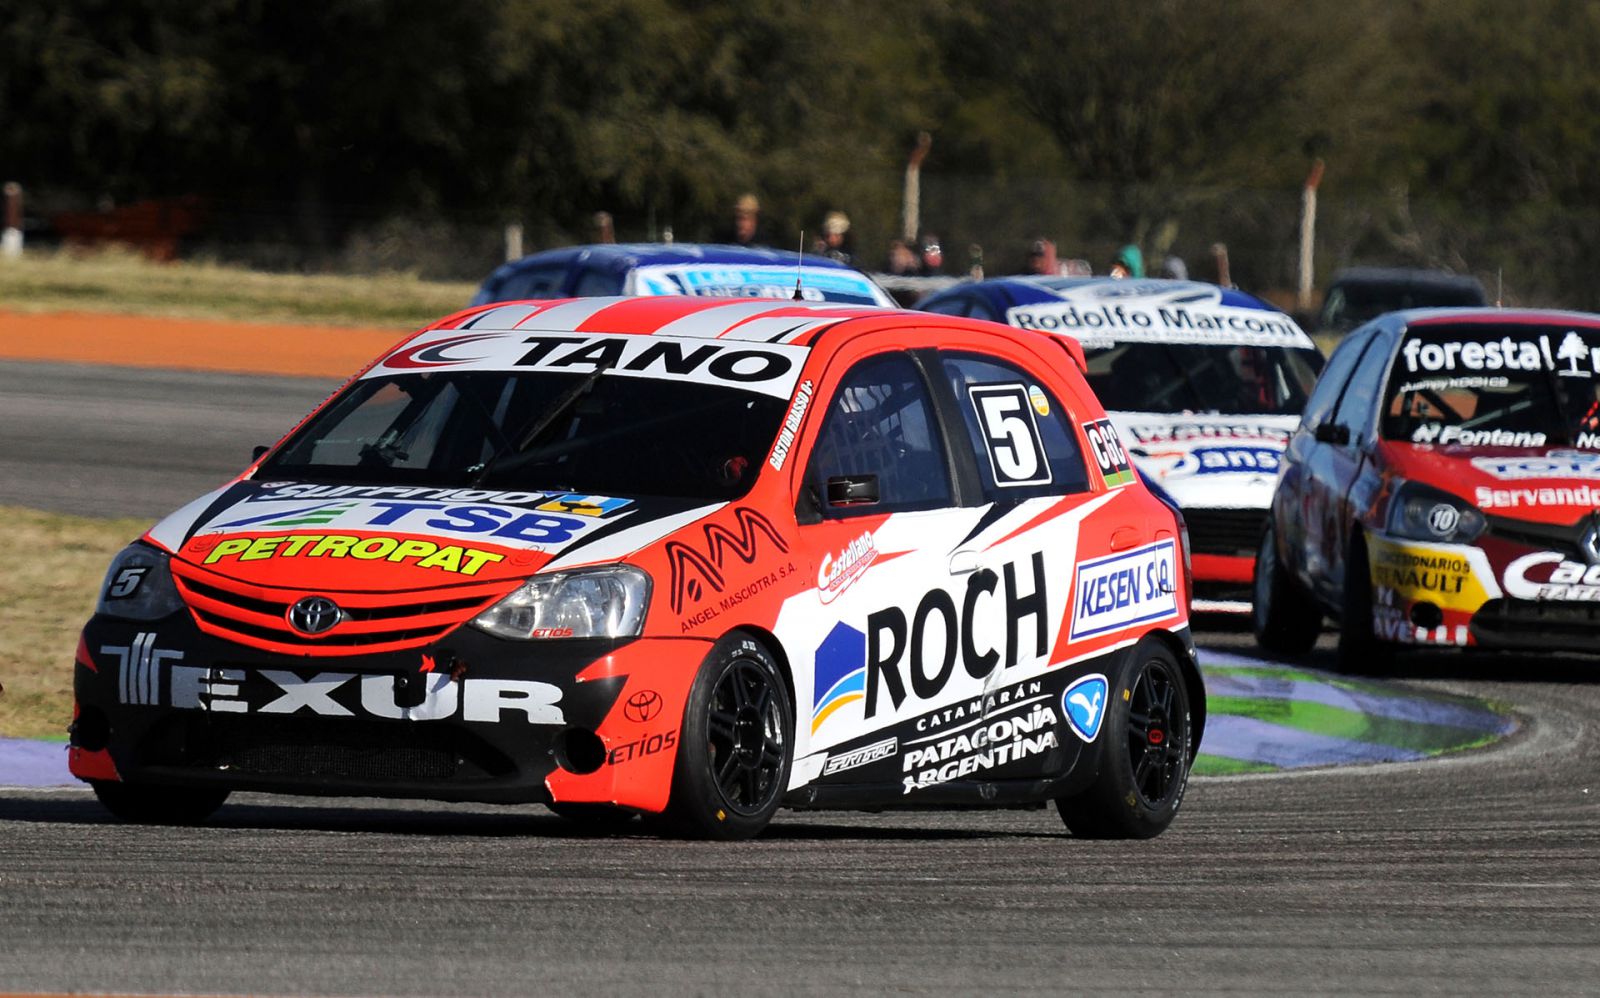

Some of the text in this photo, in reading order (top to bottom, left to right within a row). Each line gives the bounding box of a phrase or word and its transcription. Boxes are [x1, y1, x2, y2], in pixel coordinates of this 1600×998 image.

[1014, 303, 1151, 331] Rodolfo
[1158, 307, 1296, 337] Marconi
[512, 335, 793, 383] TANO
[1402, 335, 1556, 373] forestal
[769, 427, 795, 472] GASTON
[785, 391, 810, 433] GRASSO
[980, 394, 1038, 481] 5
[1439, 425, 1547, 448] Fontana
[366, 501, 587, 544] TSB
[1433, 510, 1454, 531] 10
[203, 533, 505, 576] PETROPAT
[817, 529, 875, 592] Castellano
[110, 567, 147, 597] 5
[680, 609, 720, 634] ANGEL
[720, 572, 778, 612] MASCIOTRA
[1080, 565, 1141, 619] KESEN
[864, 550, 1049, 720] ROCH
[916, 680, 1042, 732] CATAMARÁN
